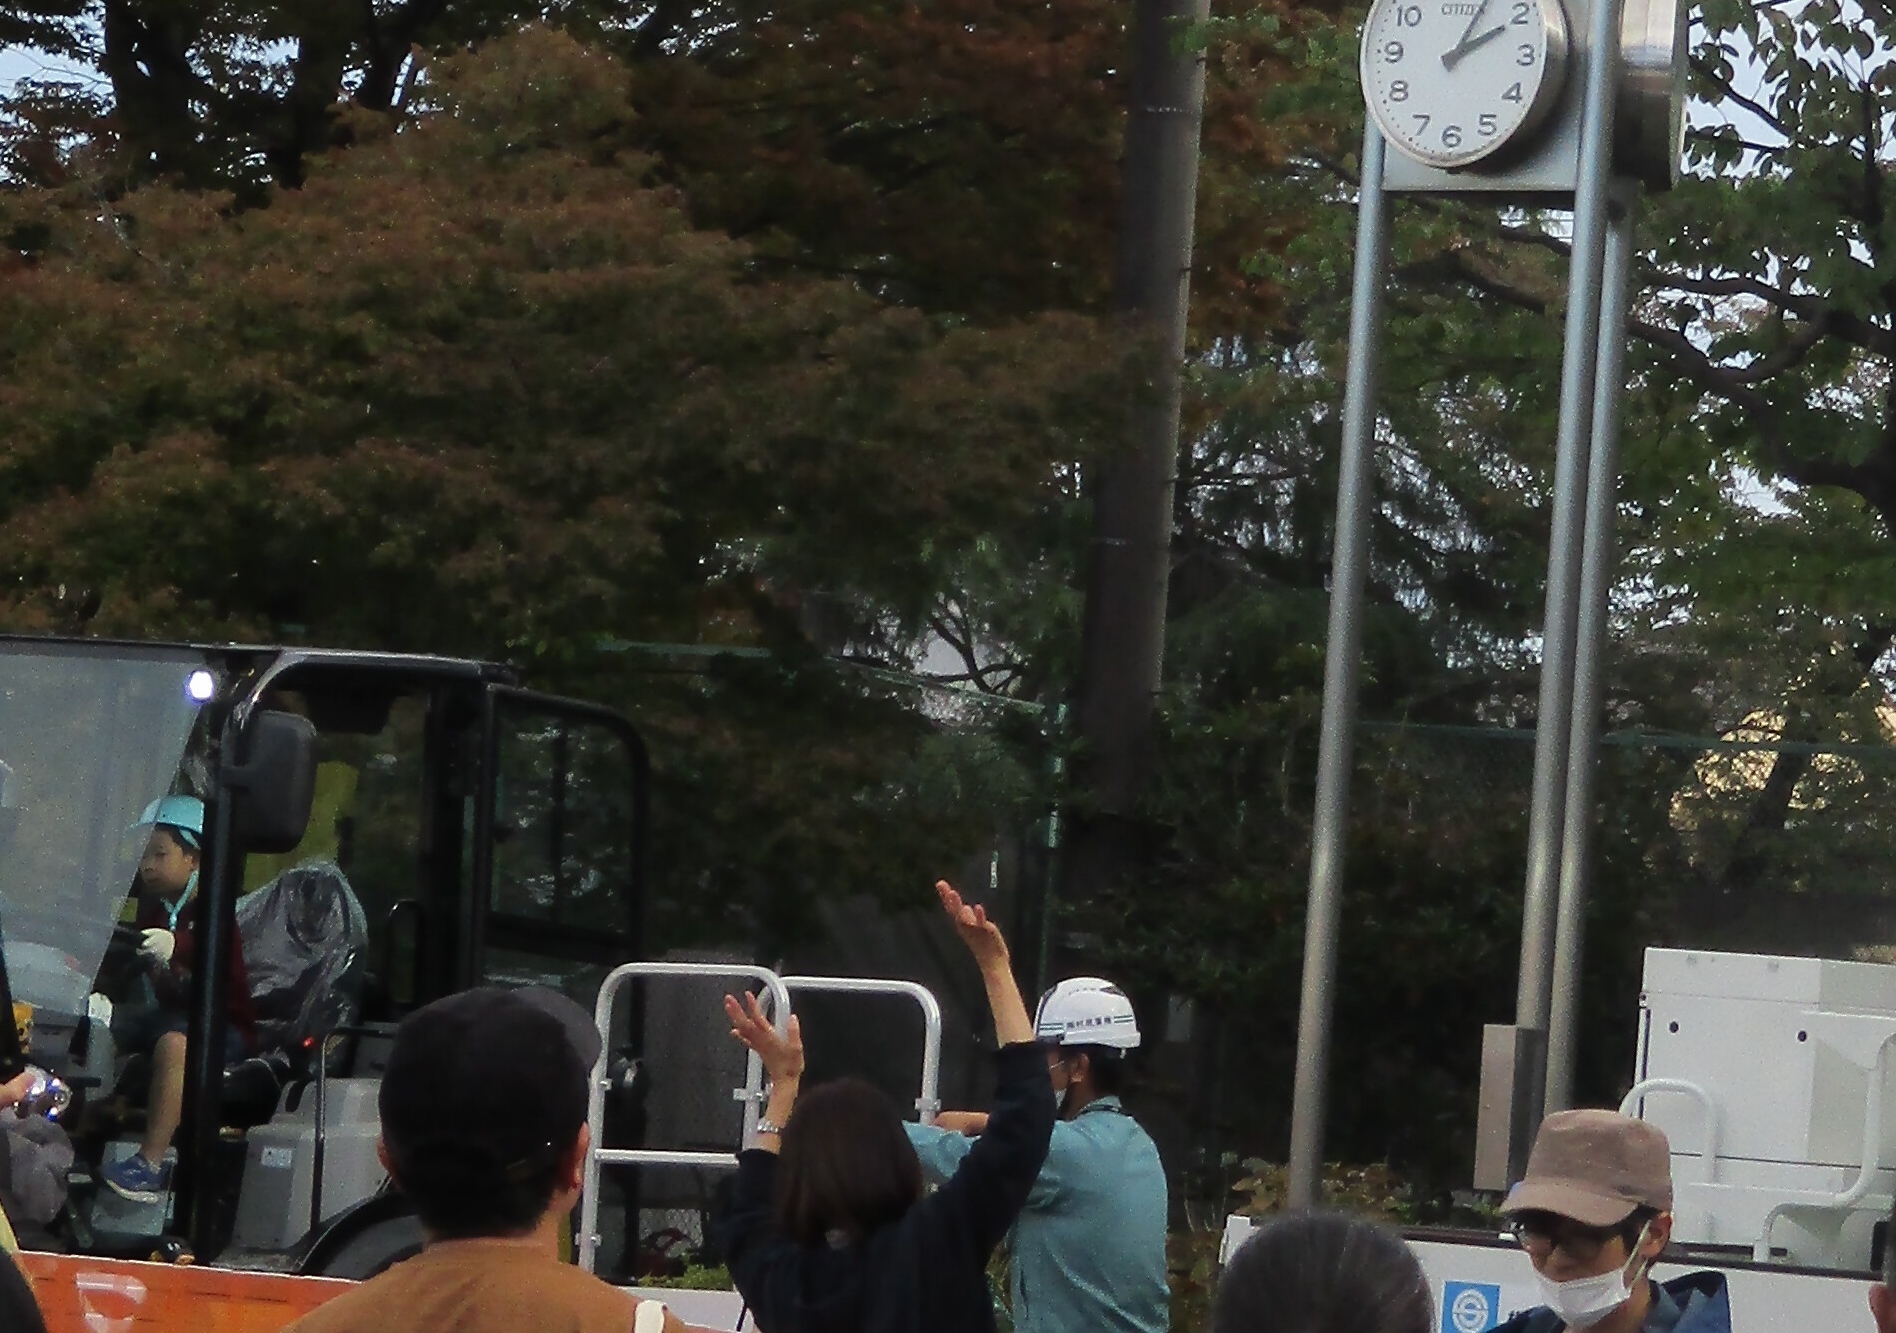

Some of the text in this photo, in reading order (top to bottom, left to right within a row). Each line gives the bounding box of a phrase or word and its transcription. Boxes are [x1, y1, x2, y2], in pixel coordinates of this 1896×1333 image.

[1397, 5, 1422, 27] 10
[1510, 2, 1530, 25] 2
[1384, 41, 1404, 63] 9
[1516, 44, 1535, 66] 3
[1389, 80, 1409, 102] 8
[1501, 82, 1522, 104] 4
[1412, 114, 1430, 136] 7
[1477, 113, 1497, 136] 5
[1442, 125, 1462, 147] 6
